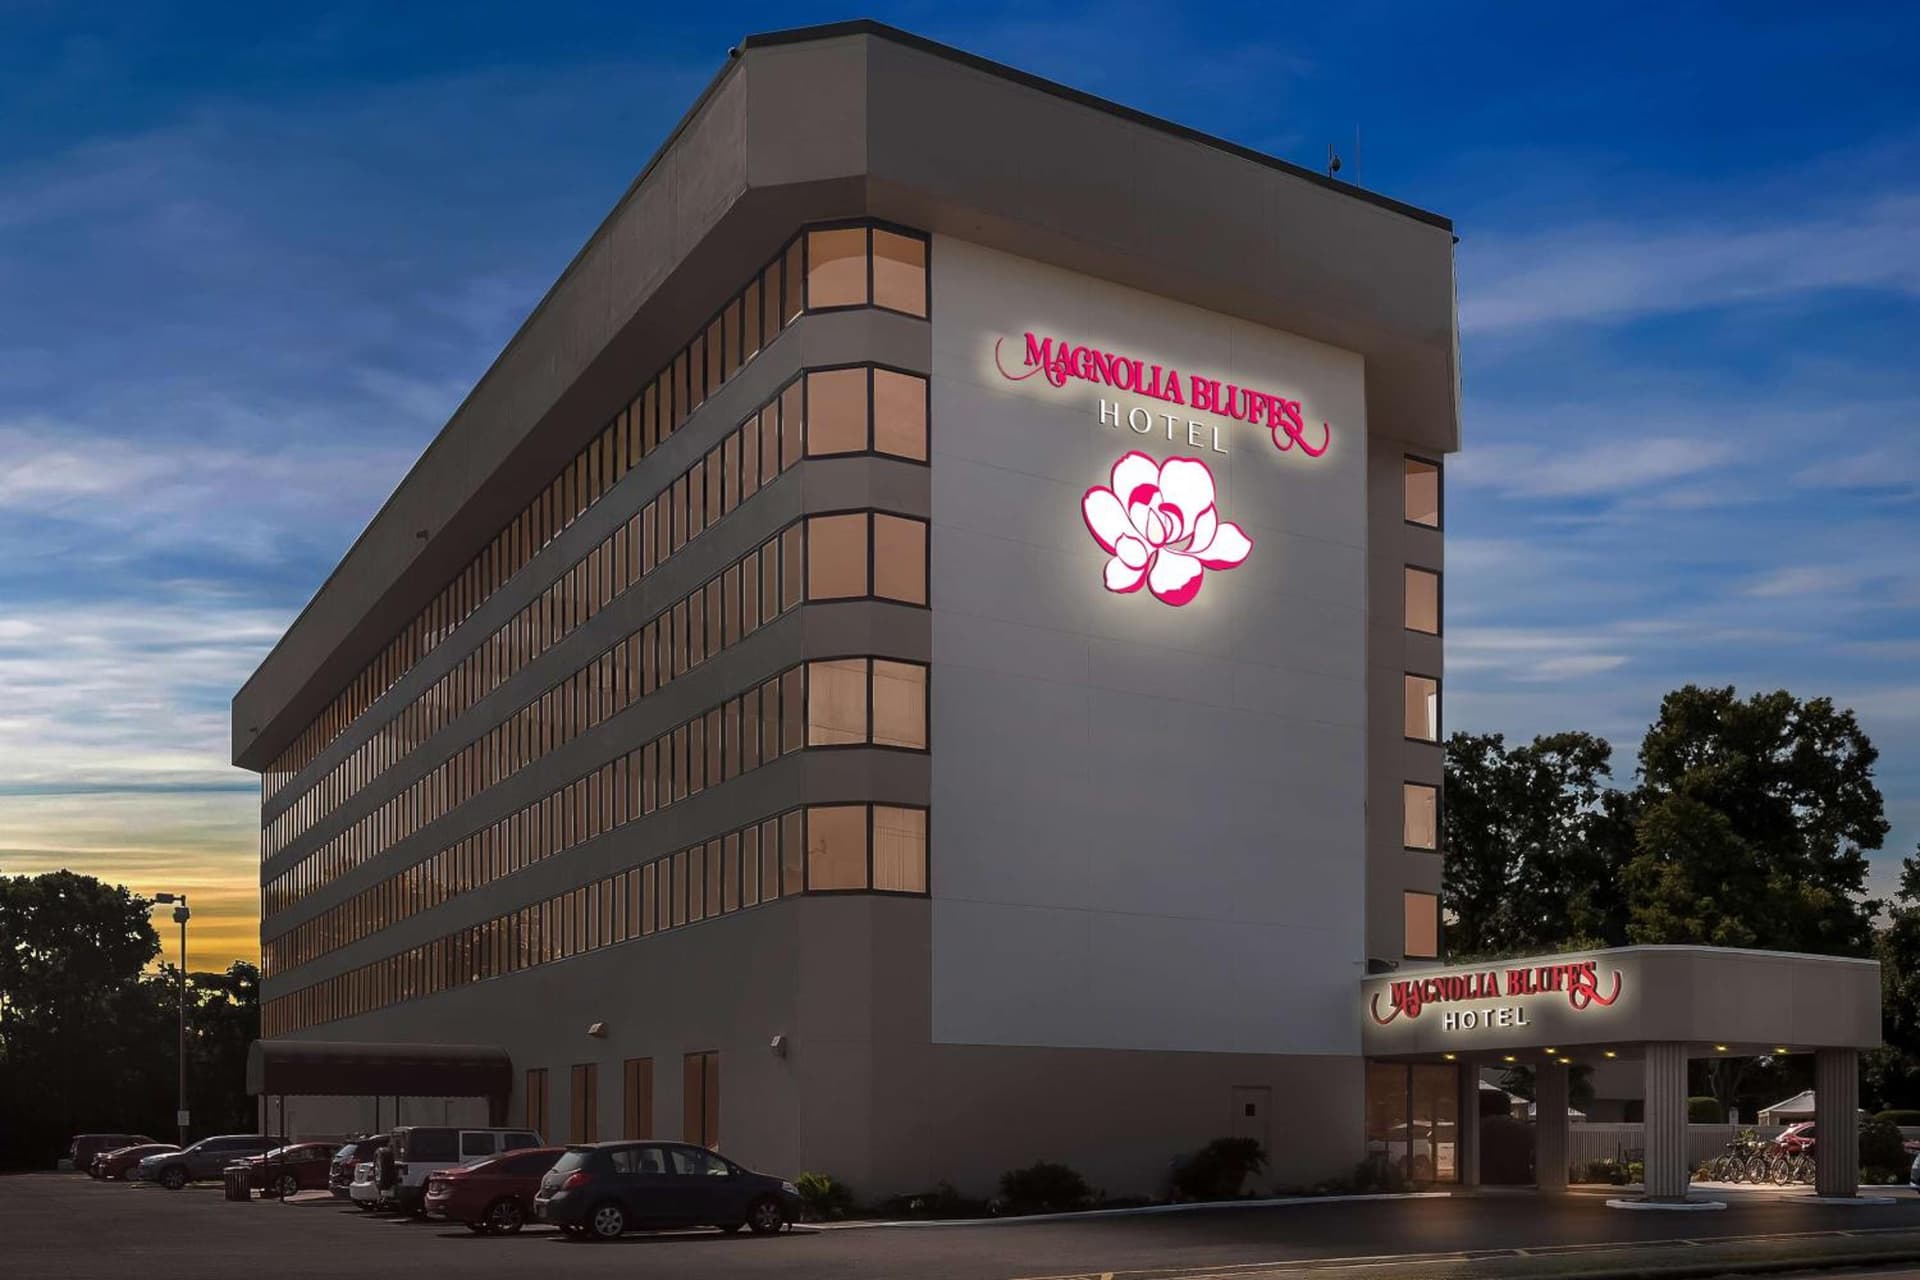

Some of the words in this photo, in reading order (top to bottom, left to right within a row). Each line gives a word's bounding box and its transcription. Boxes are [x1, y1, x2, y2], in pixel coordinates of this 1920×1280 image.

[995, 332, 1184, 405] MAGNOLIA
[1190, 376, 1331, 457] BLUFFS
[1098, 399, 1228, 454] HOTEL
[1371, 971, 1501, 1025] MAGNOLIA
[1506, 961, 1622, 1010] BLUFFS
[1443, 1006, 1531, 1032] HOTEL
